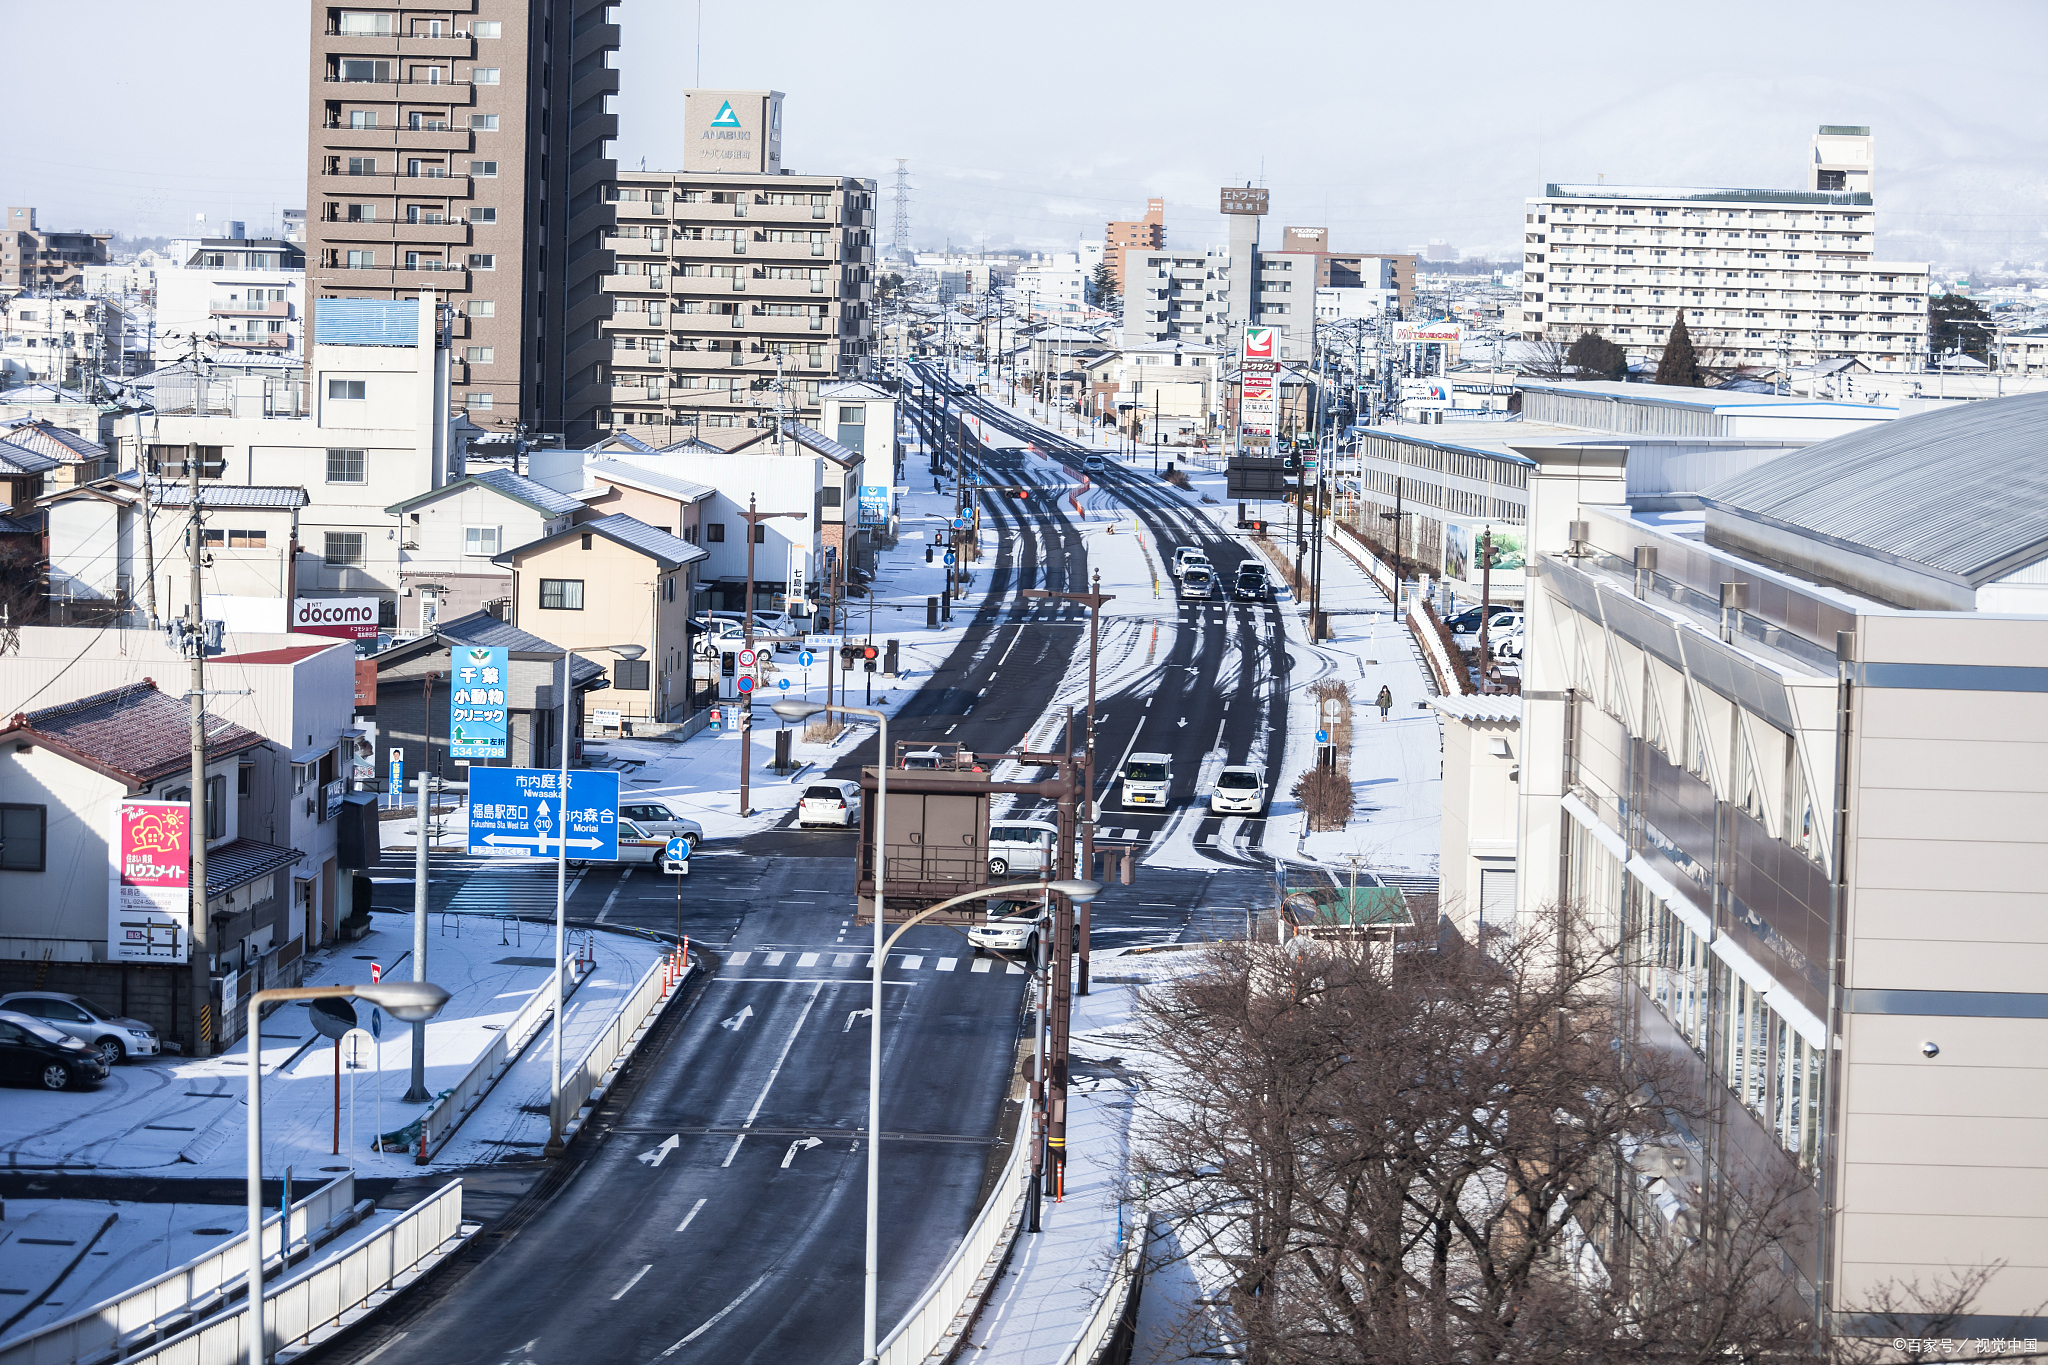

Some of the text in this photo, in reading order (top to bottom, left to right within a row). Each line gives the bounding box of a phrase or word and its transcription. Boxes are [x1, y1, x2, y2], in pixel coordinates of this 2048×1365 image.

[701, 130, 751, 140] ANABUKI
[1222, 191, 1266, 201] エトワール
[1226, 203, 1260, 211] 福島第1
[1241, 362, 1276, 371] ヨークタウン
[793, 568, 803, 597] 七島屋
[298, 602, 373, 623] docomo
[741, 655, 753, 663] 50
[459, 666, 500, 685] 千葉
[453, 688, 505, 706] 小動物
[453, 708, 504, 723] クリニック
[490, 738, 506, 746] 左折
[452, 747, 505, 757] 534-2798
[515, 774, 573, 790] 市内庭坂
[472, 803, 529, 820] 福島駅西口
[471, 819, 530, 830] Fukushima Sta. West Exit
[536, 820, 549, 829] 310
[573, 823, 599, 833] Moriai
[124, 863, 186, 879] ハウスメイト
[120, 888, 141, 897] 福島店
